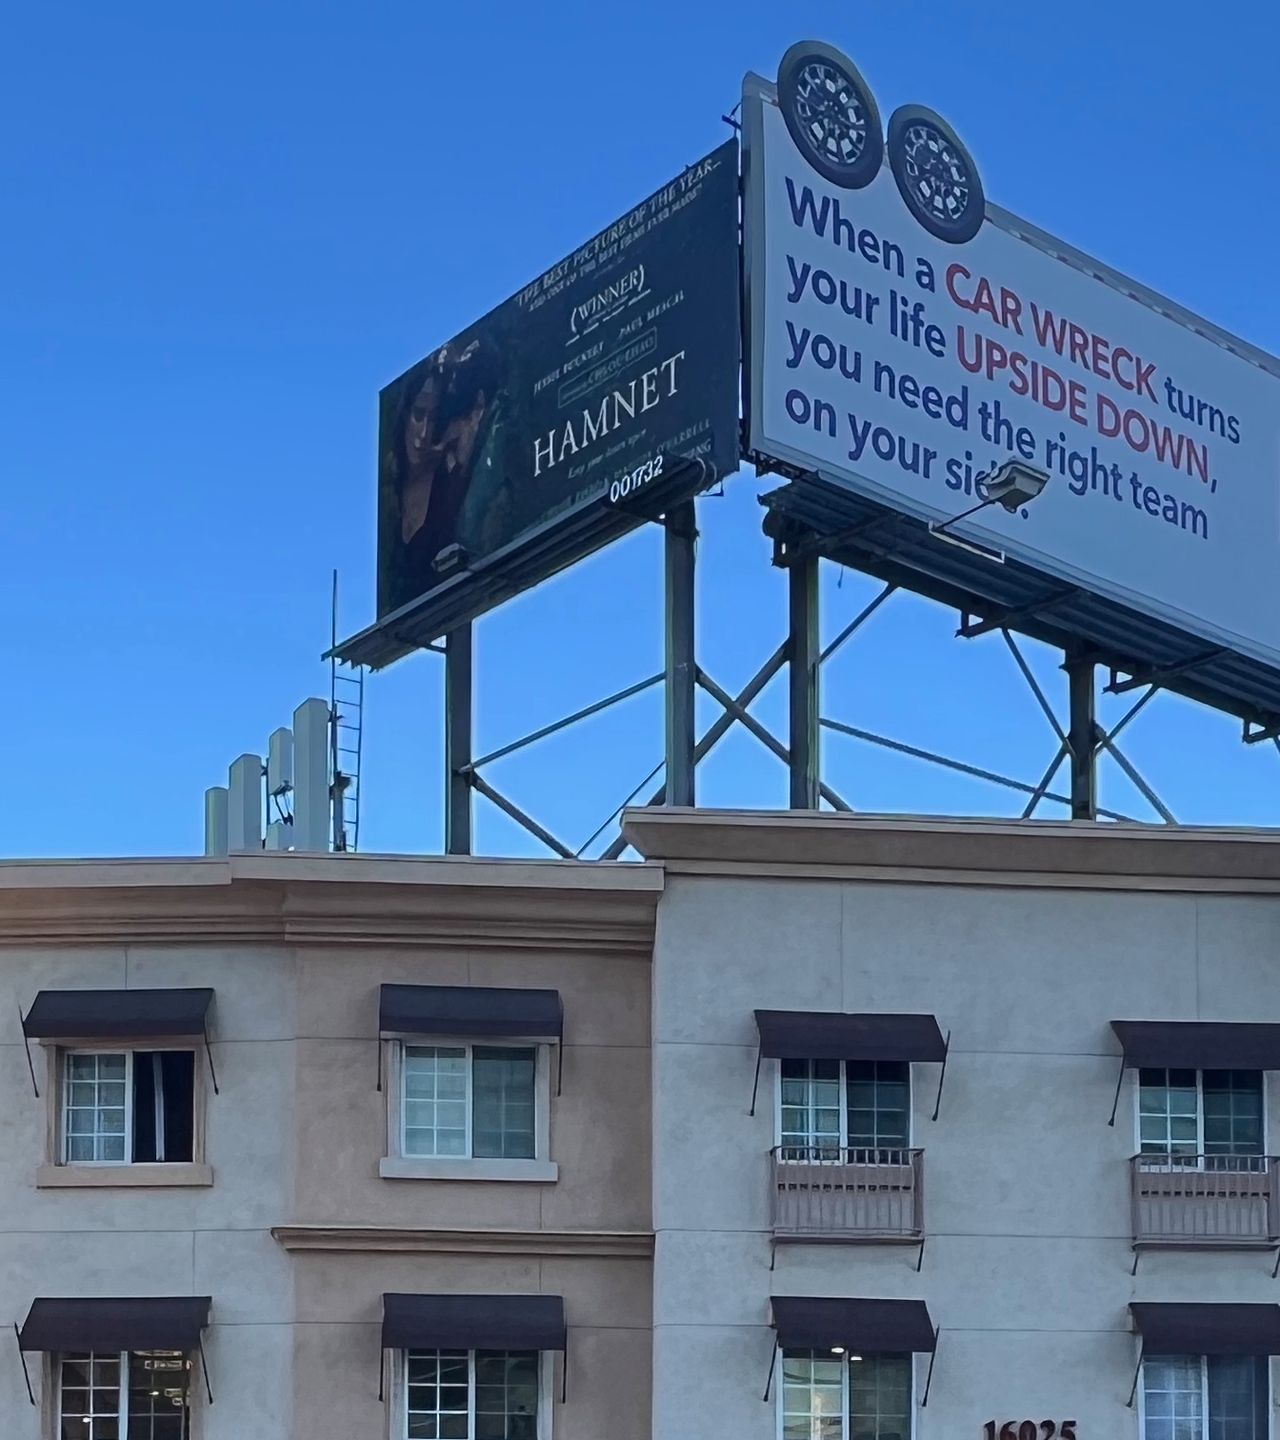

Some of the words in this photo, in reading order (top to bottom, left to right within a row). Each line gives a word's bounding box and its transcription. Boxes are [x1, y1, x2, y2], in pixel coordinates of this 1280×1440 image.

[785, 176, 904, 278] When
[915, 257, 935, 293] a
[946, 263, 1024, 335] CAR
[1030, 301, 1159, 404] WRECK
[1164, 376, 1240, 444] turns
[786, 254, 880, 325] your
[889, 289, 946, 358] life
[957, 325, 1088, 426] UPSIDE
[1096, 392, 1217, 493] DOWN,
[533, 350, 685, 477] HAMNET
[610, 454, 664, 503] 001732
[785, 320, 862, 383] you
[874, 360, 968, 430] need
[978, 400, 1036, 459] the
[1046, 431, 1123, 501] right
[1130, 471, 1208, 539] team
[785, 388, 837, 437] on
[847, 413, 937, 479] your
[945, 450, 1029, 520] si.
